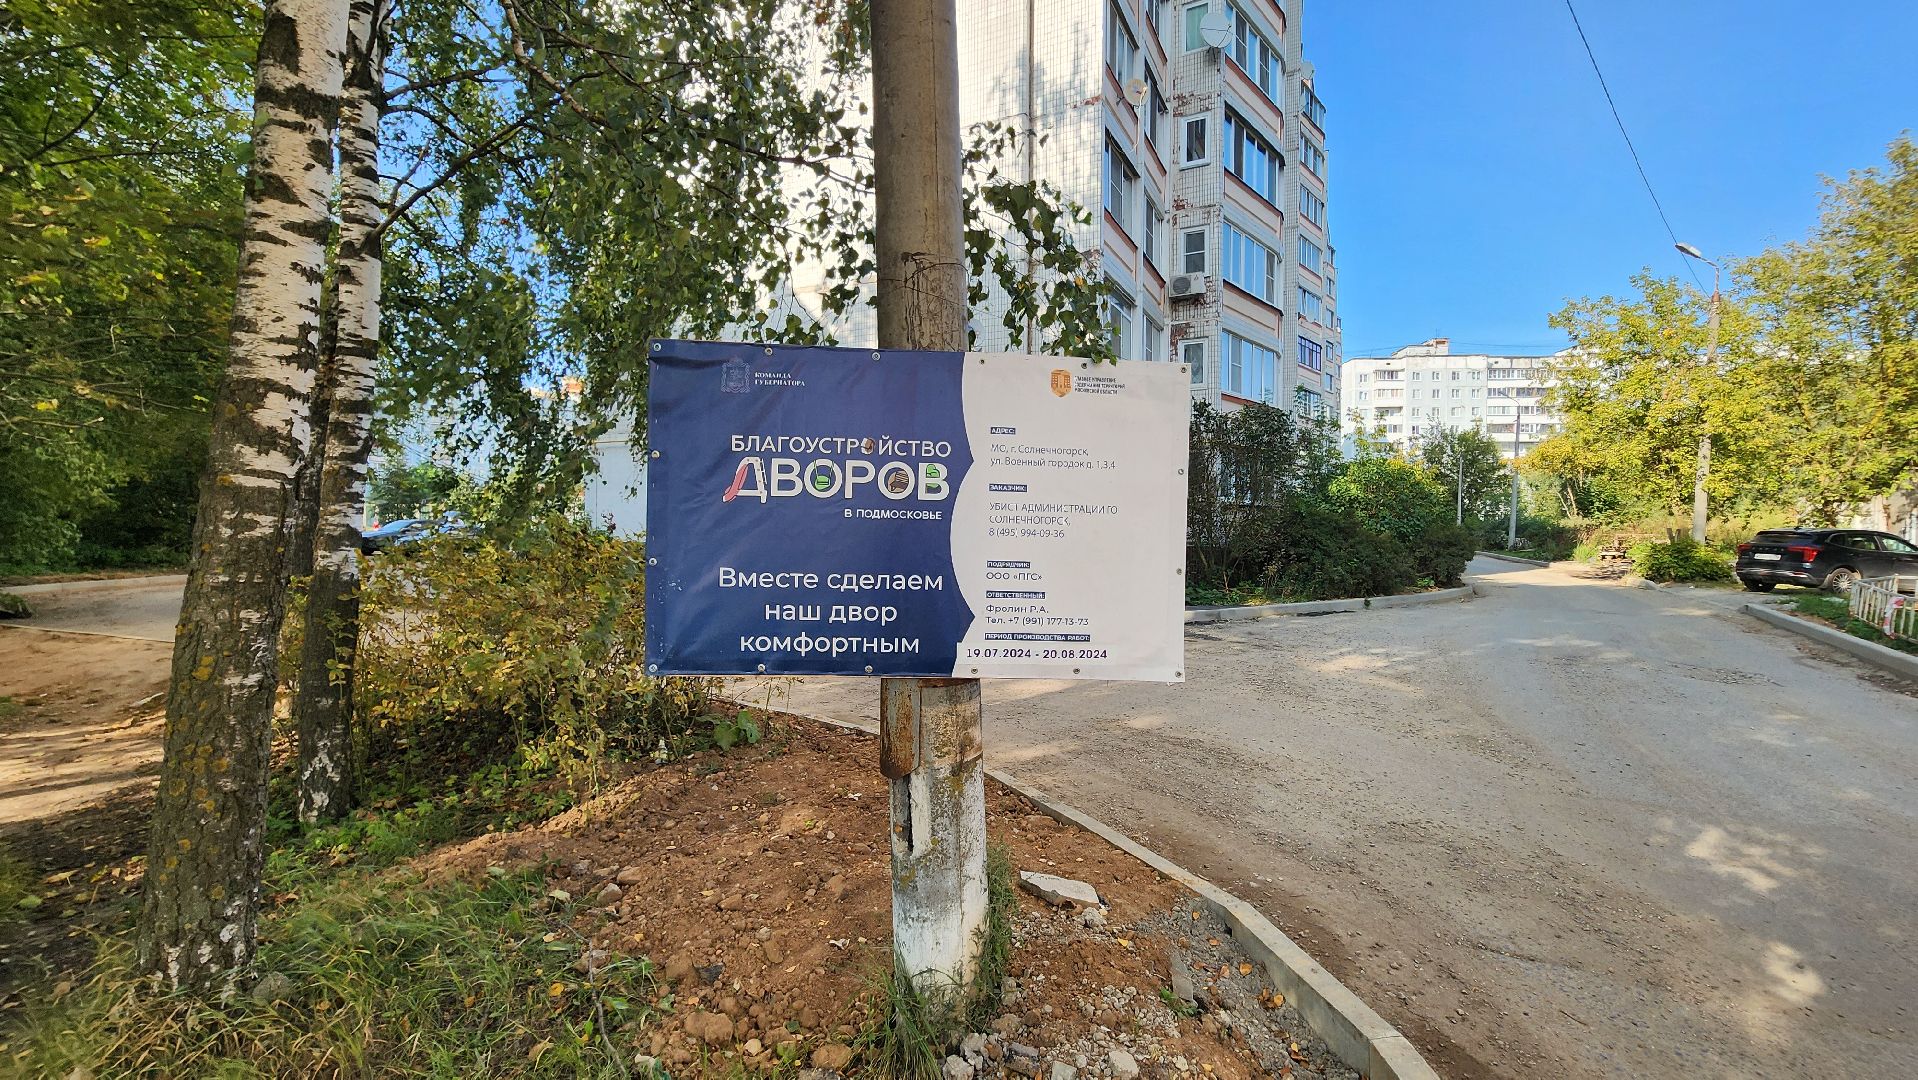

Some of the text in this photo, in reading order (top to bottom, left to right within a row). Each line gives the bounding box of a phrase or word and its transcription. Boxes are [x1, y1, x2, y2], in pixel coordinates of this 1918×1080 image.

[755, 371, 791, 379] КОМАНДА
[754, 379, 806, 387] ГУБЕРНАТОРА
[991, 427, 1015, 435] АДРЕС:
[731, 434, 952, 457] БЛАГОУСТРОЙСТВО
[990, 444, 1089, 457] МО, г. Солнечногорск,
[990, 457, 1116, 470] ул. Военный городок д. 1,3,4
[722, 456, 950, 504] ДВОРОВ
[989, 484, 1027, 492] ЗАКАЗЧИК:
[844, 508, 942, 520] В ПОДМОСКОВЬЕ
[1021, 503, 1105, 515] АДМИНИСТРАЦИИ
[1107, 505, 1118, 514] ГО
[988, 528, 1065, 538] 8 (495) 994-09-36
[718, 567, 943, 592] Вместе сделаем
[985, 572, 1042, 581] ООО «ПГС»
[986, 591, 1045, 599] ОТВЕТСТВЕННЫЙ:
[985, 604, 1049, 614] Фролин Р.А.
[765, 604, 898, 626] наш двор
[985, 616, 1089, 627] Тел. +7 (991) 177-13-73
[740, 631, 920, 657] комфортным
[966, 648, 1031, 658] 19.07.2024
[1043, 649, 1107, 659] 20.08.2024
